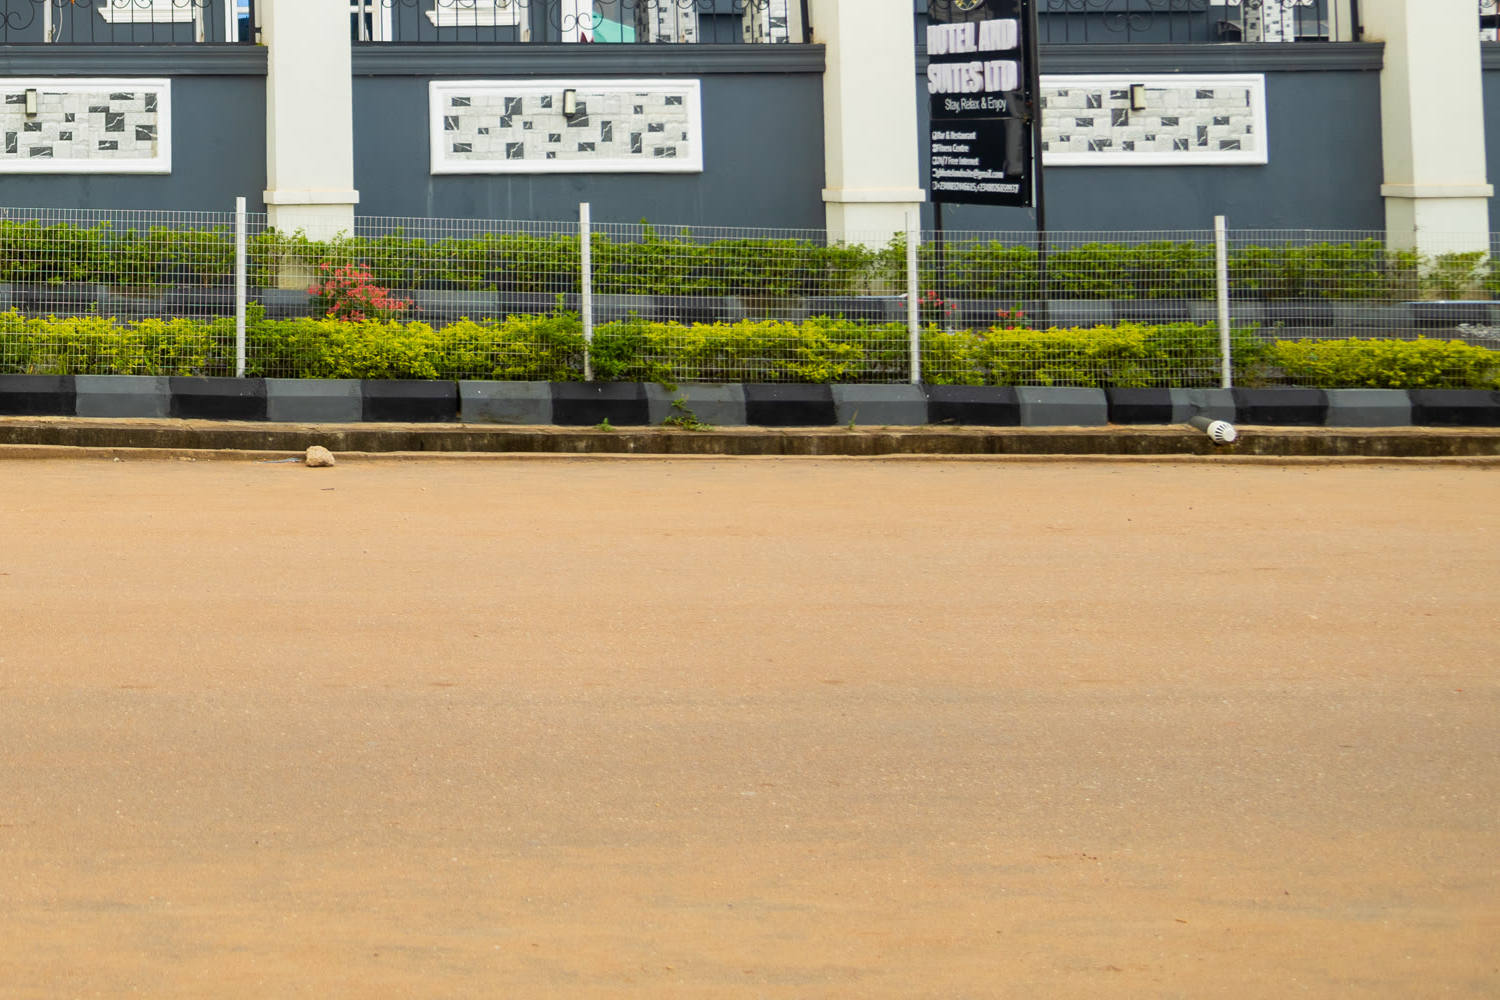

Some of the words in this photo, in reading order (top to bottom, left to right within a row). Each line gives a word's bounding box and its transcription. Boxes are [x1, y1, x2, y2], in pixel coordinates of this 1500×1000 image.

[927, 22, 977, 55] HOTEL
[978, 19, 1018, 51] AND
[927, 61, 984, 94] SUITES
[984, 60, 1018, 92] LTD
[944, 98, 960, 113] Stay,
[961, 98, 980, 110] Relax
[981, 97, 987, 109] &
[987, 97, 1007, 112] Enjoy
